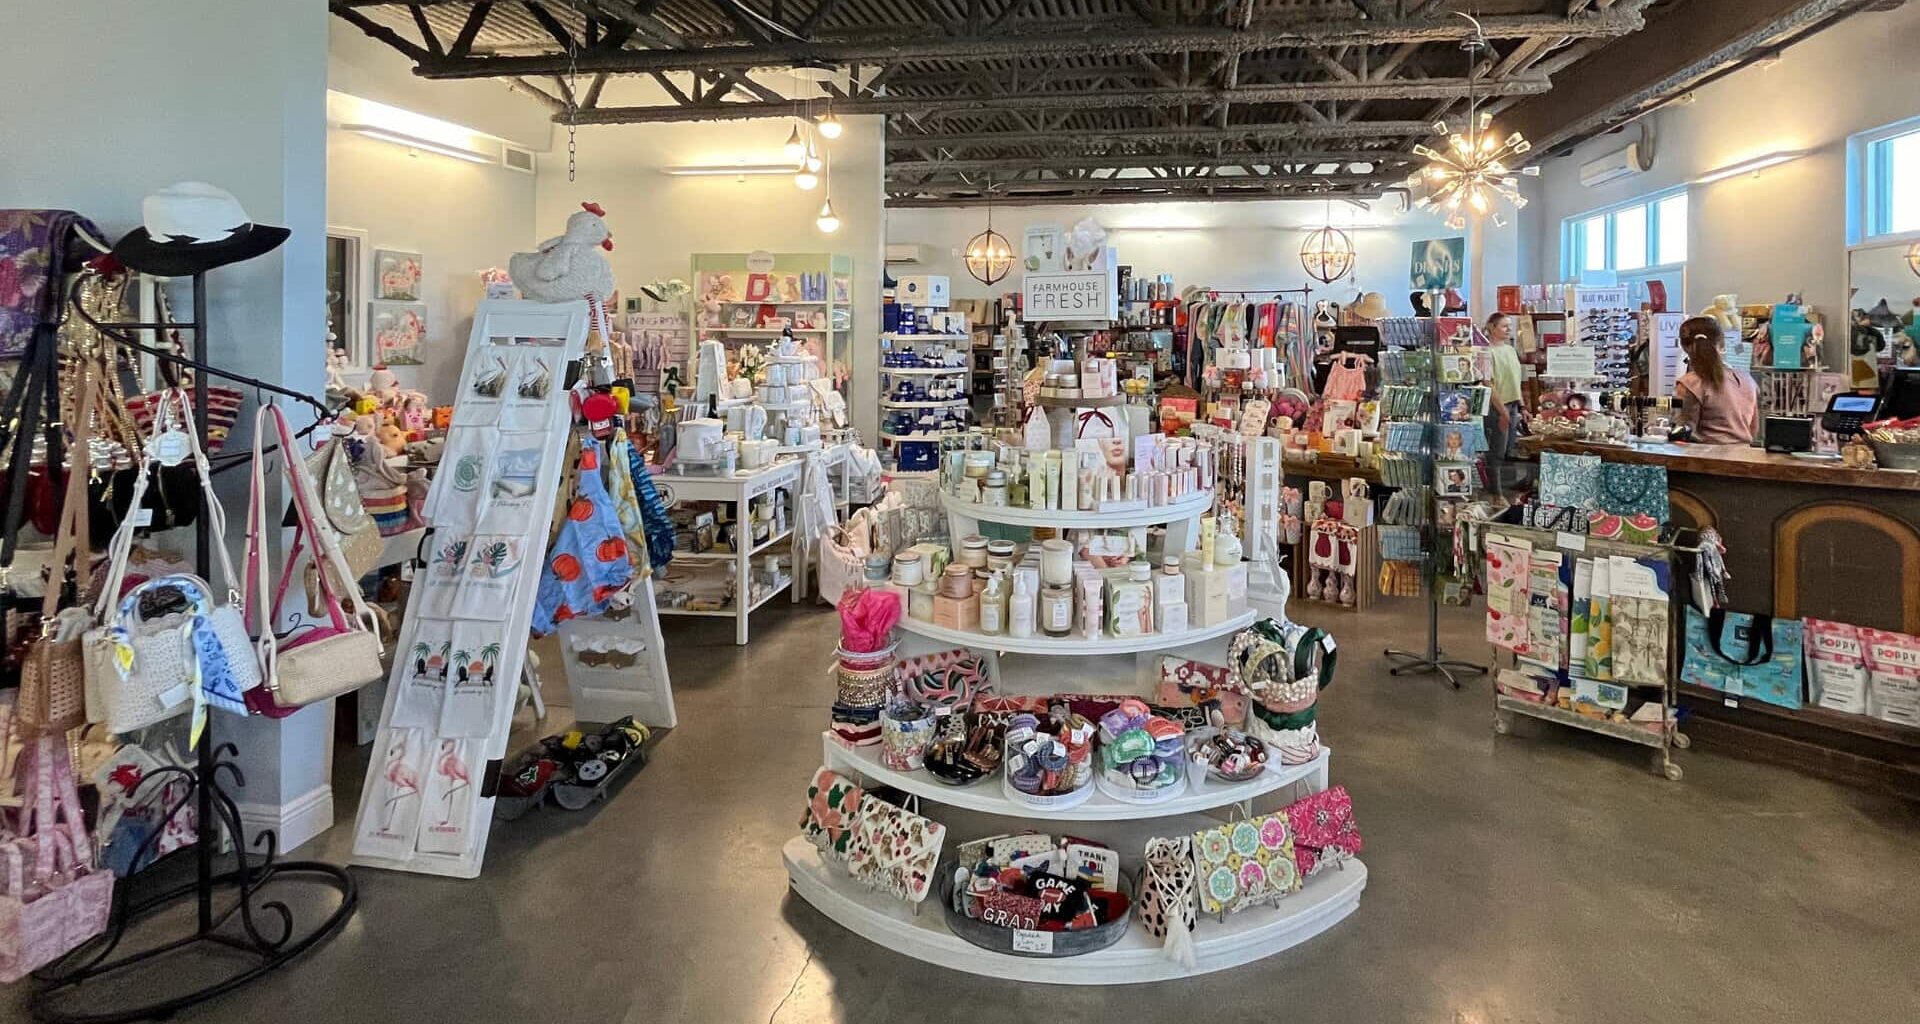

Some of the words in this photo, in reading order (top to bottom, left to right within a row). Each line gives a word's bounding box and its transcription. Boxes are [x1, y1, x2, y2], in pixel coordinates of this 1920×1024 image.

[1032, 282, 1098, 292] FARMHOUSE
[1033, 292, 1099, 309] FRESH
[1078, 850, 1106, 862] THANK
[1035, 878, 1077, 895] GAME
[983, 907, 1035, 930] GRAD
